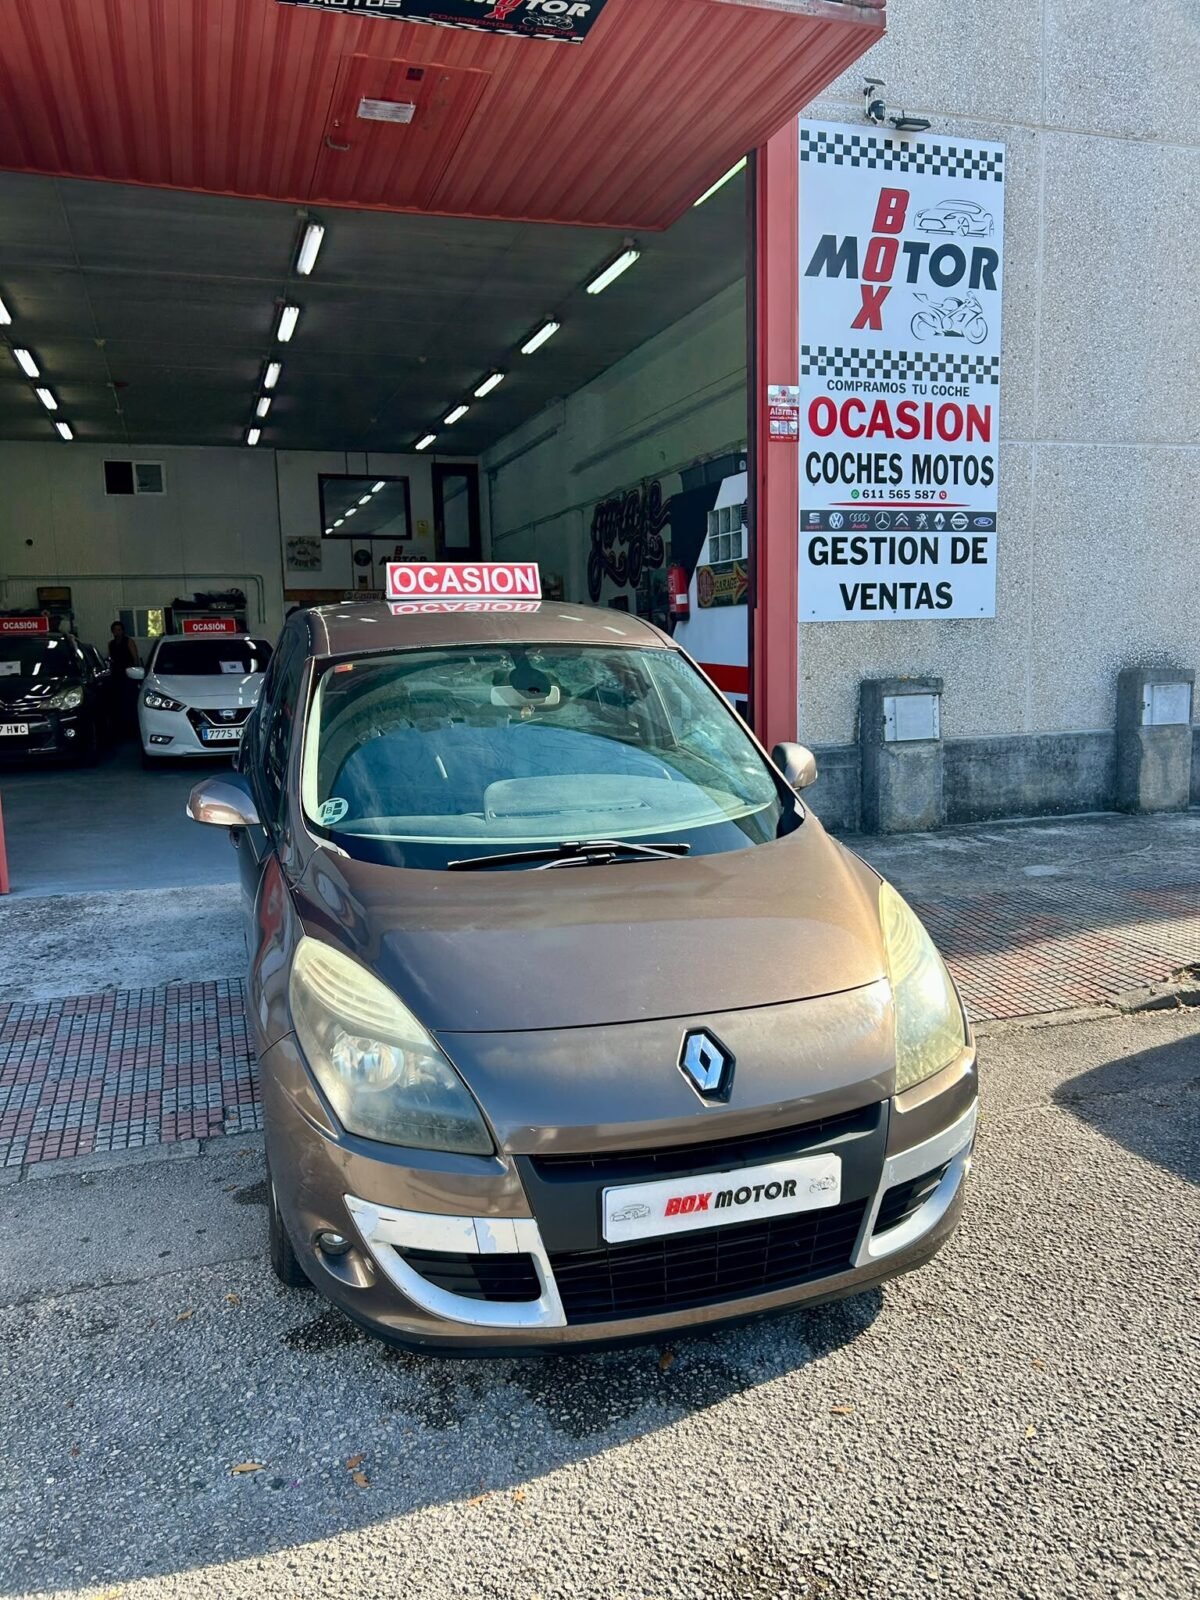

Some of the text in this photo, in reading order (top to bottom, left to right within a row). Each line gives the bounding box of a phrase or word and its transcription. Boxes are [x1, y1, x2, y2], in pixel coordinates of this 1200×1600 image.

[804, 234, 999, 292] MOTOR
[826, 380, 970, 398] COMPRAMOS TU COCHE
[770, 407, 797, 416] Alarma
[807, 396, 993, 443] OCASION
[805, 451, 994, 487] COCHES MOTOS
[862, 489, 936, 500] 611 565 587
[807, 536, 988, 566] GESTION DE
[392, 566, 536, 593] OCASION
[839, 581, 953, 611] VENTAS
[2, 620, 38, 630] OCASIÓN
[192, 621, 226, 631] OCASIÓN
[7, 724, 26, 734] HWC
[209, 729, 233, 738] 7775
[663, 1178, 798, 1217] BOX MOTOR
